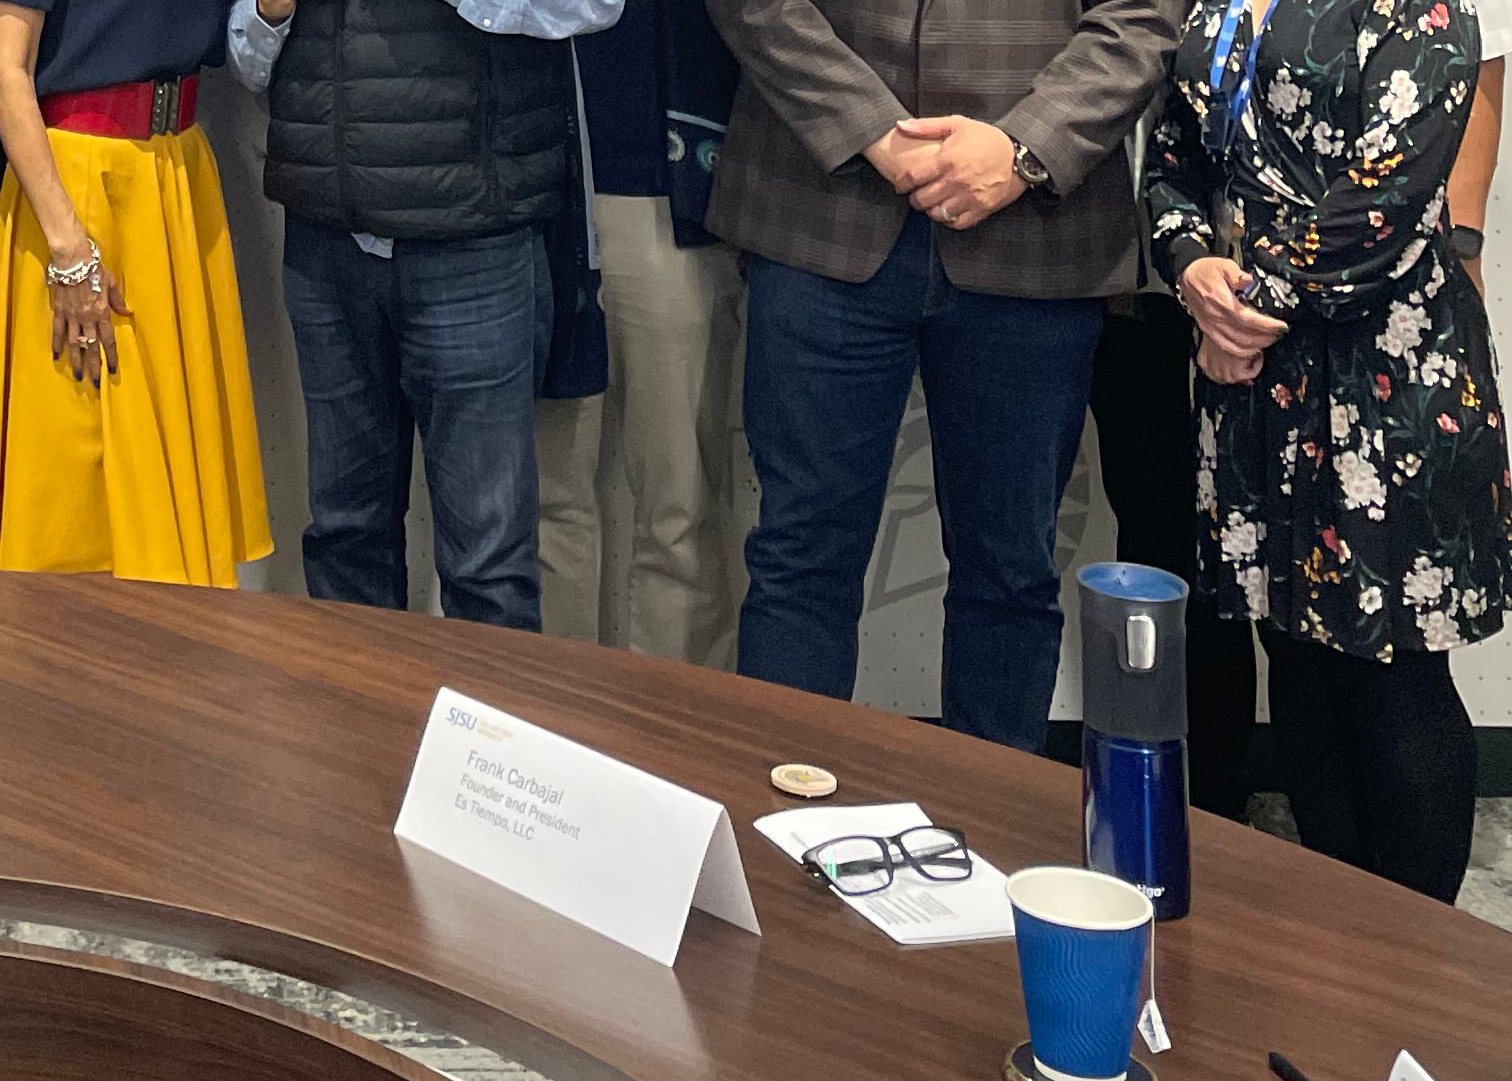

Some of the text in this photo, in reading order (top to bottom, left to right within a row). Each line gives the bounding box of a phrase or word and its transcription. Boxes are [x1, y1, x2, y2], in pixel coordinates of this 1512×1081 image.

[447, 707, 477, 730] SJSU
[467, 750, 565, 805] Frank Carbajal
[455, 793, 535, 841] Es Tiempo, LLC
[460, 773, 581, 840] Founder and President
